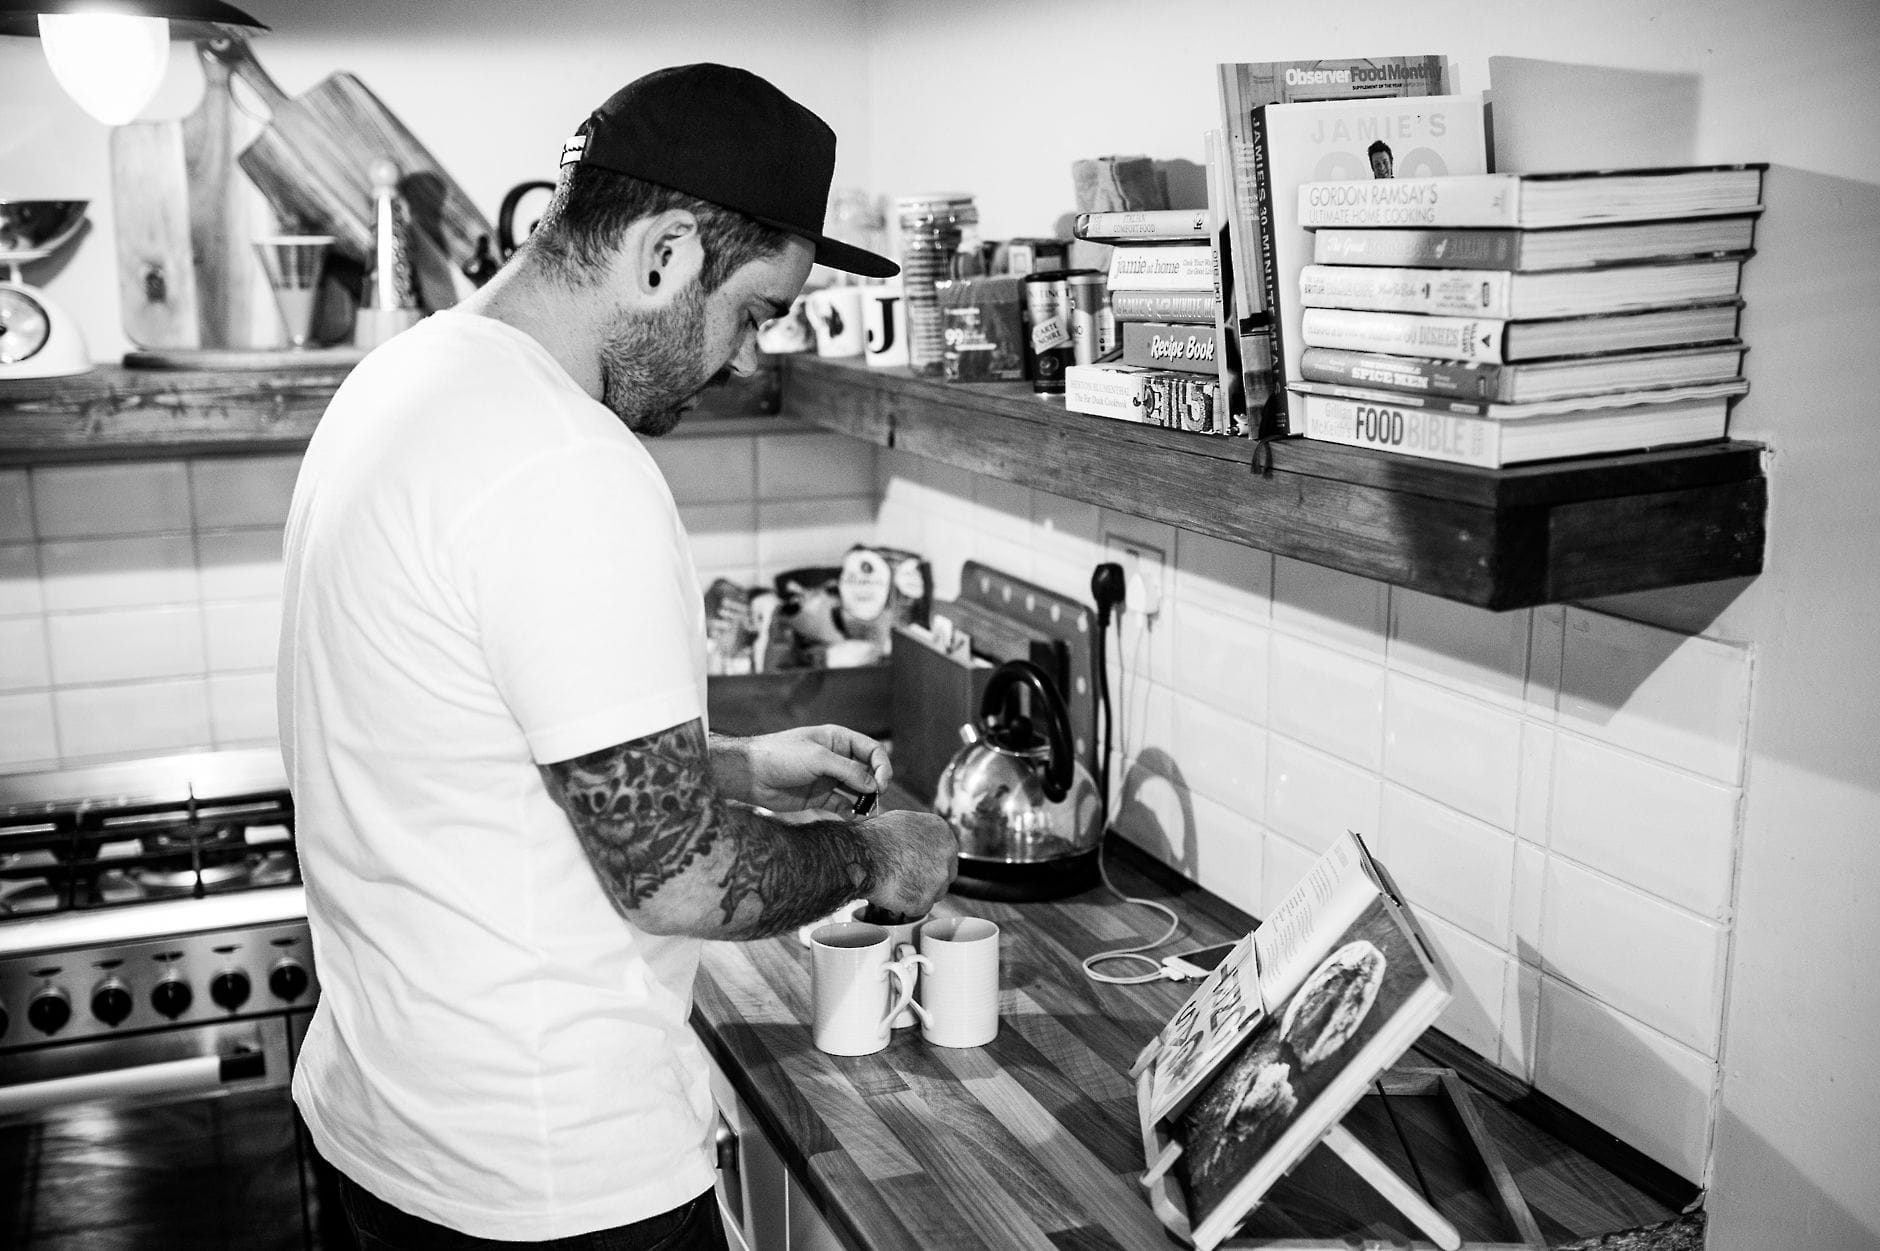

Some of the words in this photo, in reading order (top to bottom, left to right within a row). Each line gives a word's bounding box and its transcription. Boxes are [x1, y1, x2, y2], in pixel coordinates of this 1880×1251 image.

[1285, 68, 1350, 86] Observer
[1350, 64, 1387, 83] Food
[1388, 61, 1443, 82] Monthly
[1309, 112, 1448, 144] JAMIE'S
[1252, 116, 1267, 202] JAMIE'S
[1309, 185, 1368, 207] GORDON
[1372, 183, 1439, 206] RAMSAY'S
[1113, 223, 1139, 233] COMFORT
[1139, 223, 1156, 233] FOOD
[1309, 209, 1349, 224] ULTIMATE
[1352, 208, 1381, 223] HOME
[1385, 207, 1436, 223] COOKING
[1113, 256, 1147, 279] jamie
[1154, 259, 1180, 275] home
[867, 296, 901, 354] J
[1151, 334, 1184, 362] Recipe
[1186, 335, 1215, 362] Book
[1351, 367, 1394, 385] SPICE
[1394, 373, 1429, 389] MEN
[1355, 405, 1405, 447] FOOD
[1406, 411, 1466, 457] BIBLE
